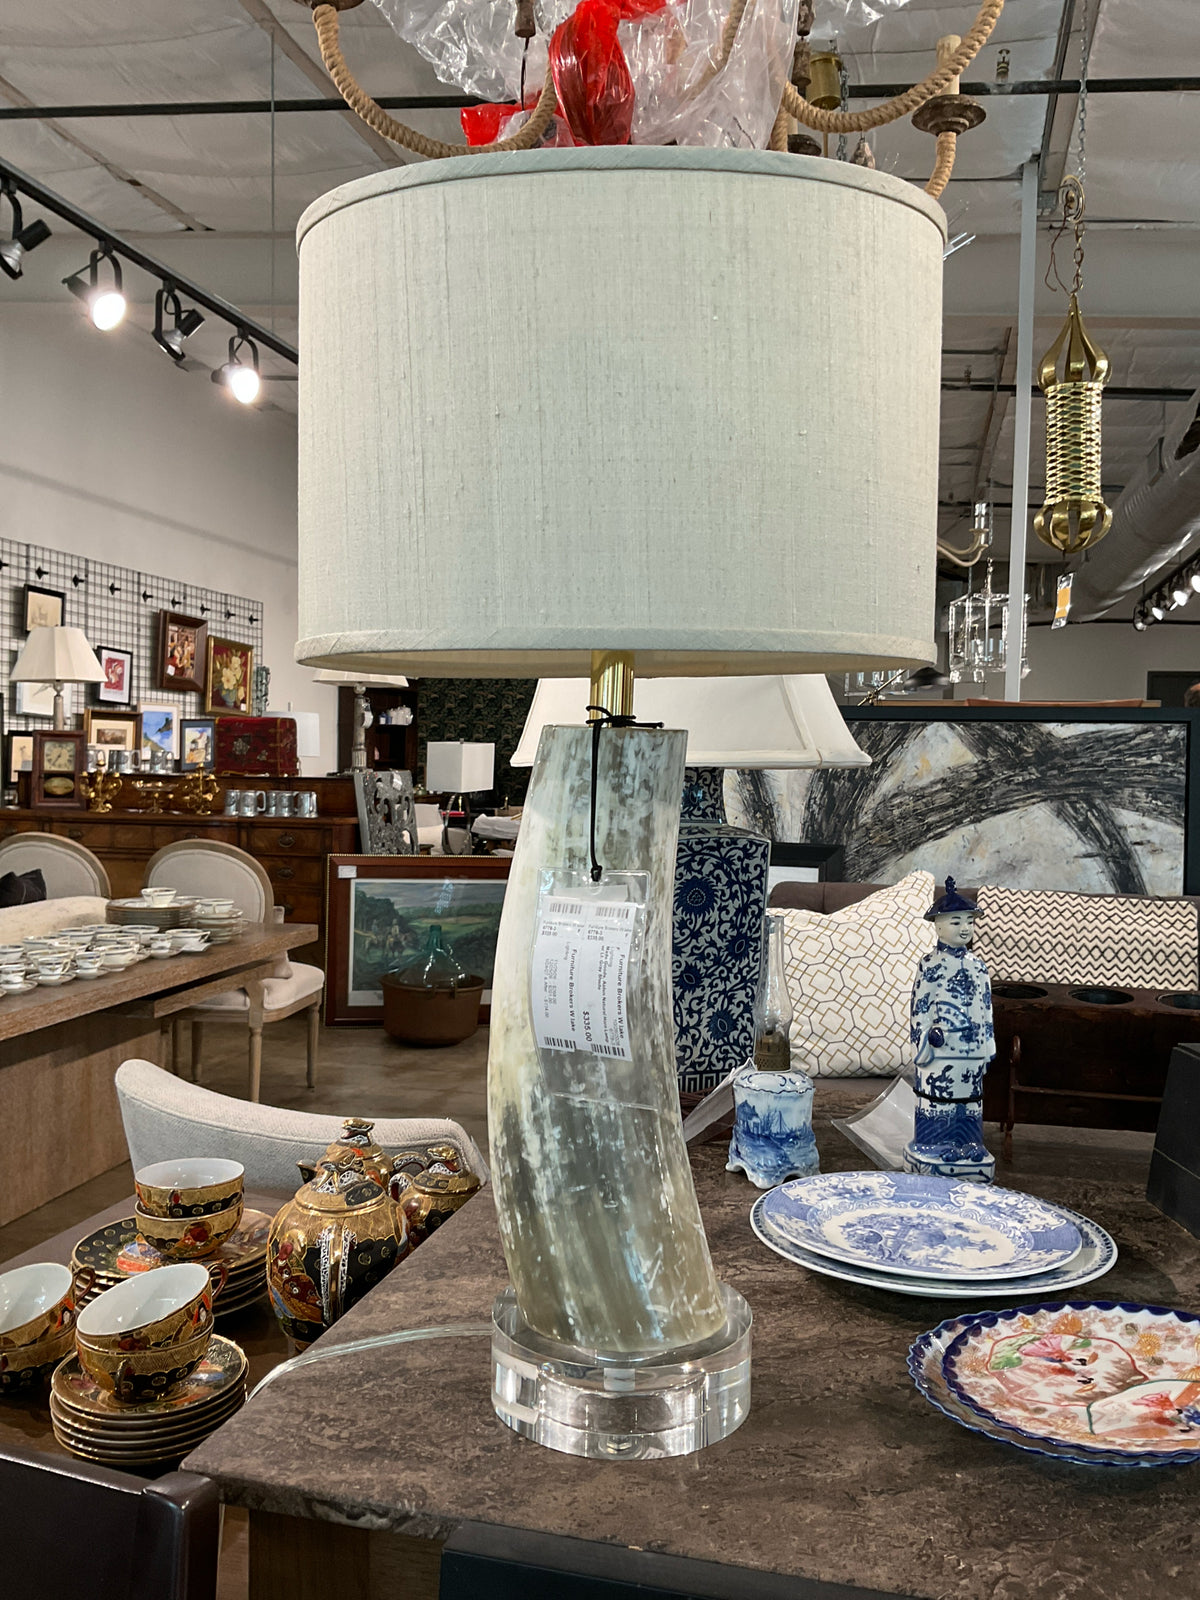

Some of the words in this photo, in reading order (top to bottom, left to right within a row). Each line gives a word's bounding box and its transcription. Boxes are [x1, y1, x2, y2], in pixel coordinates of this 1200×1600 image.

[569, 949, 577, 980] Furniture
[617, 954, 625, 986] Furniture
[583, 1011, 592, 1042] $335.00
